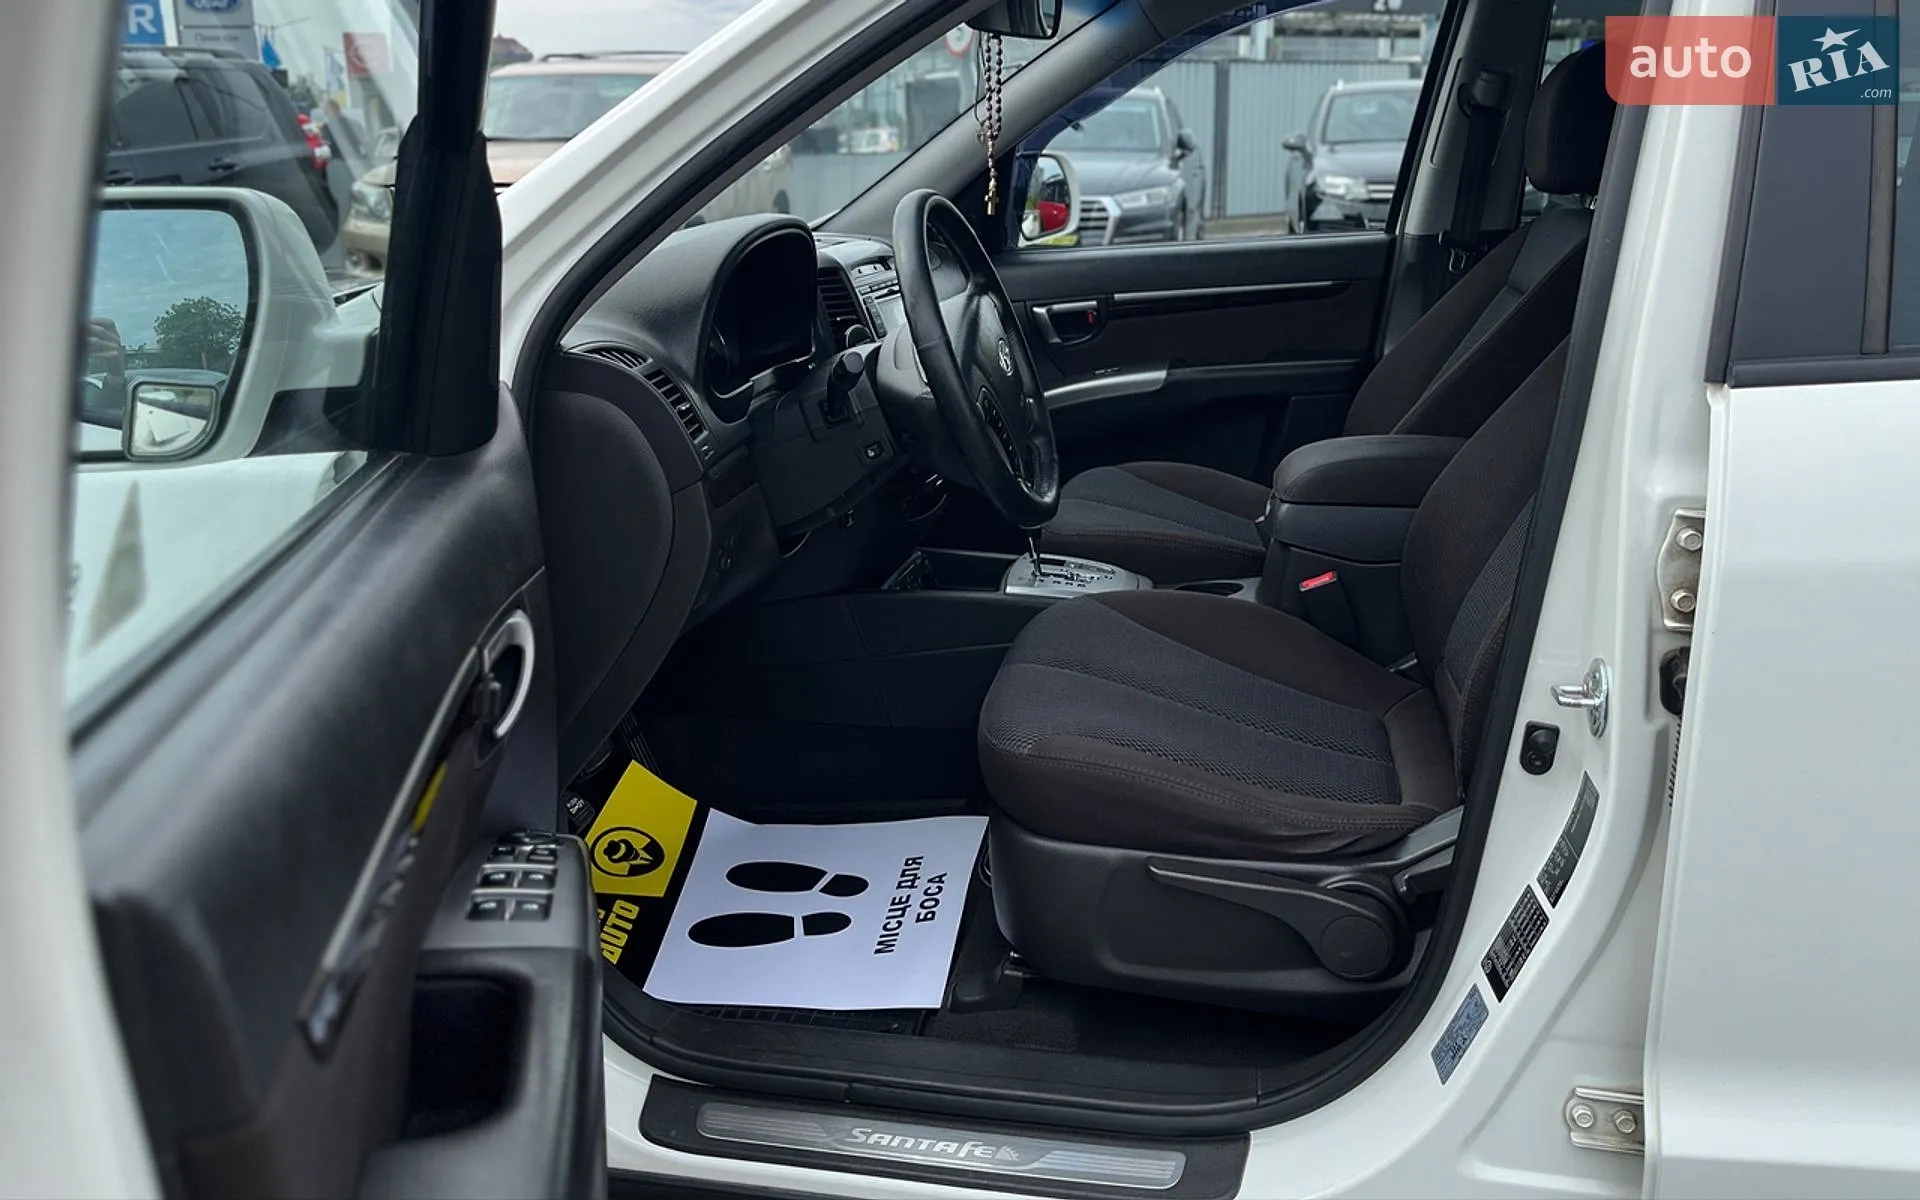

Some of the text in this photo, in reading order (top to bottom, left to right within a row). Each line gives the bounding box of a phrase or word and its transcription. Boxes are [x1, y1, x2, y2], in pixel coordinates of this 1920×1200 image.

[874, 856, 924, 955] МІСЦЕ ДЛЯ
[915, 872, 948, 923] БОСА
[600, 899, 640, 965] AUTO
